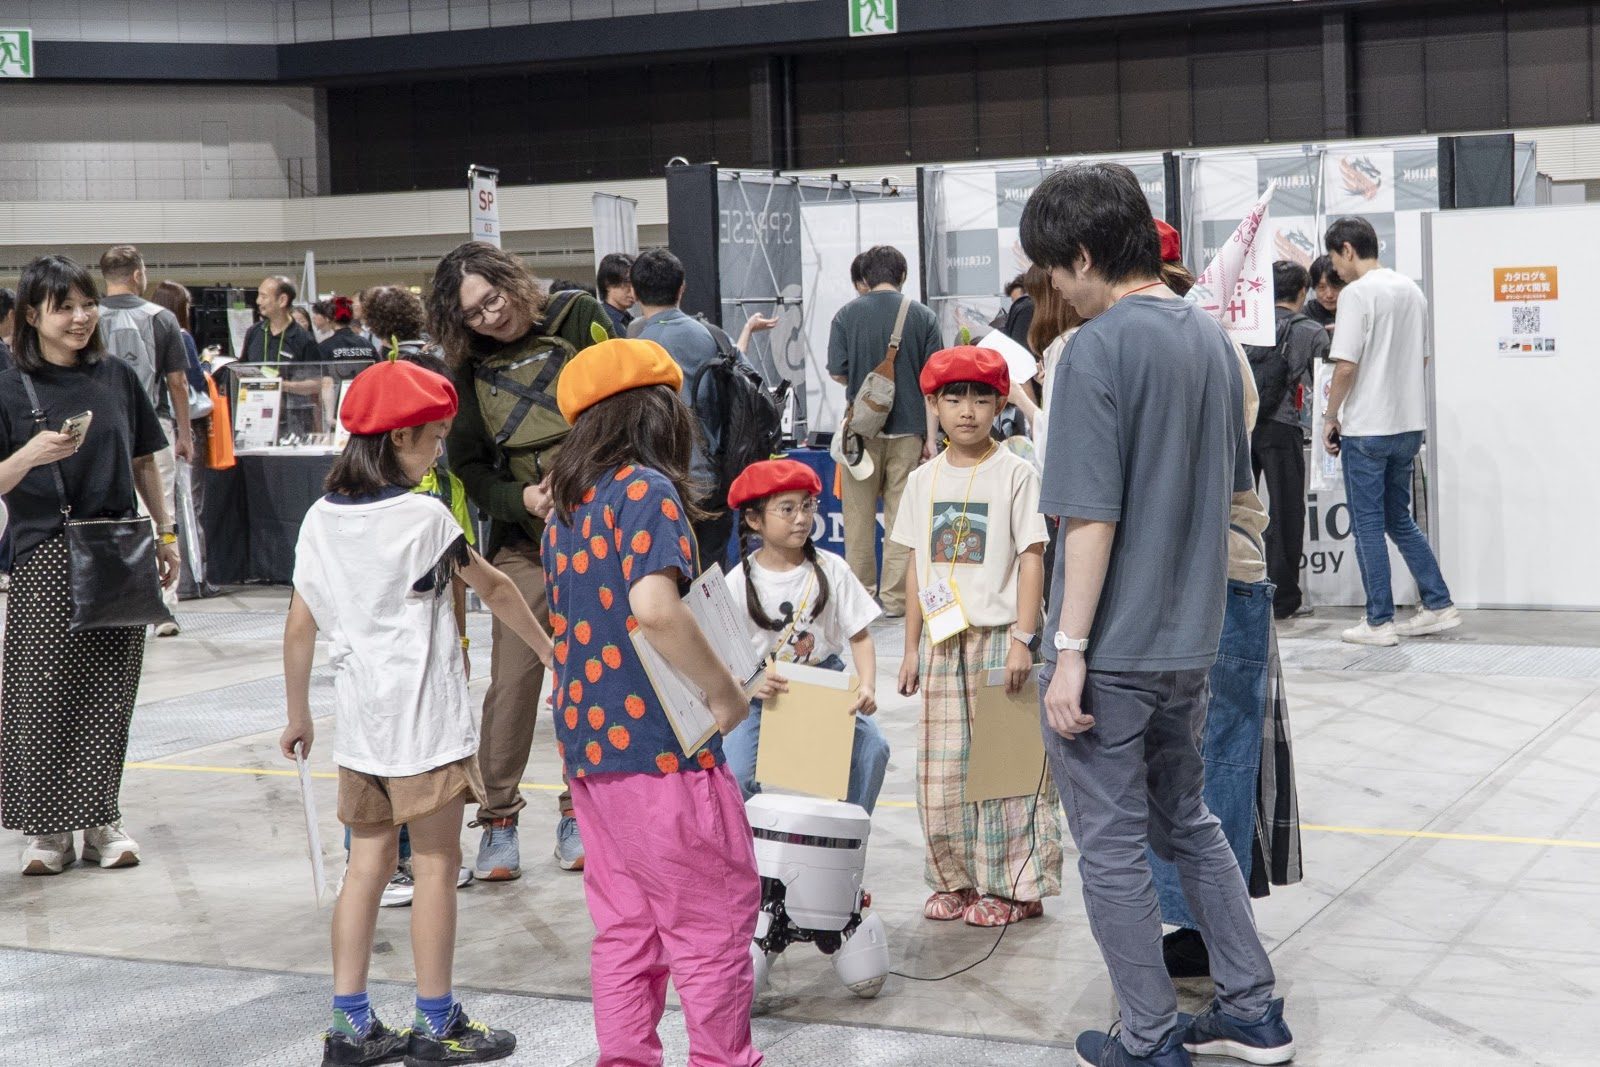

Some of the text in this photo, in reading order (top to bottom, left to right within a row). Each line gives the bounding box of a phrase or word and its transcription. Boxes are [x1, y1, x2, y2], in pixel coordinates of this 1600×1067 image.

[479, 190, 494, 211] SP
[1504, 271, 1546, 281] カタログを
